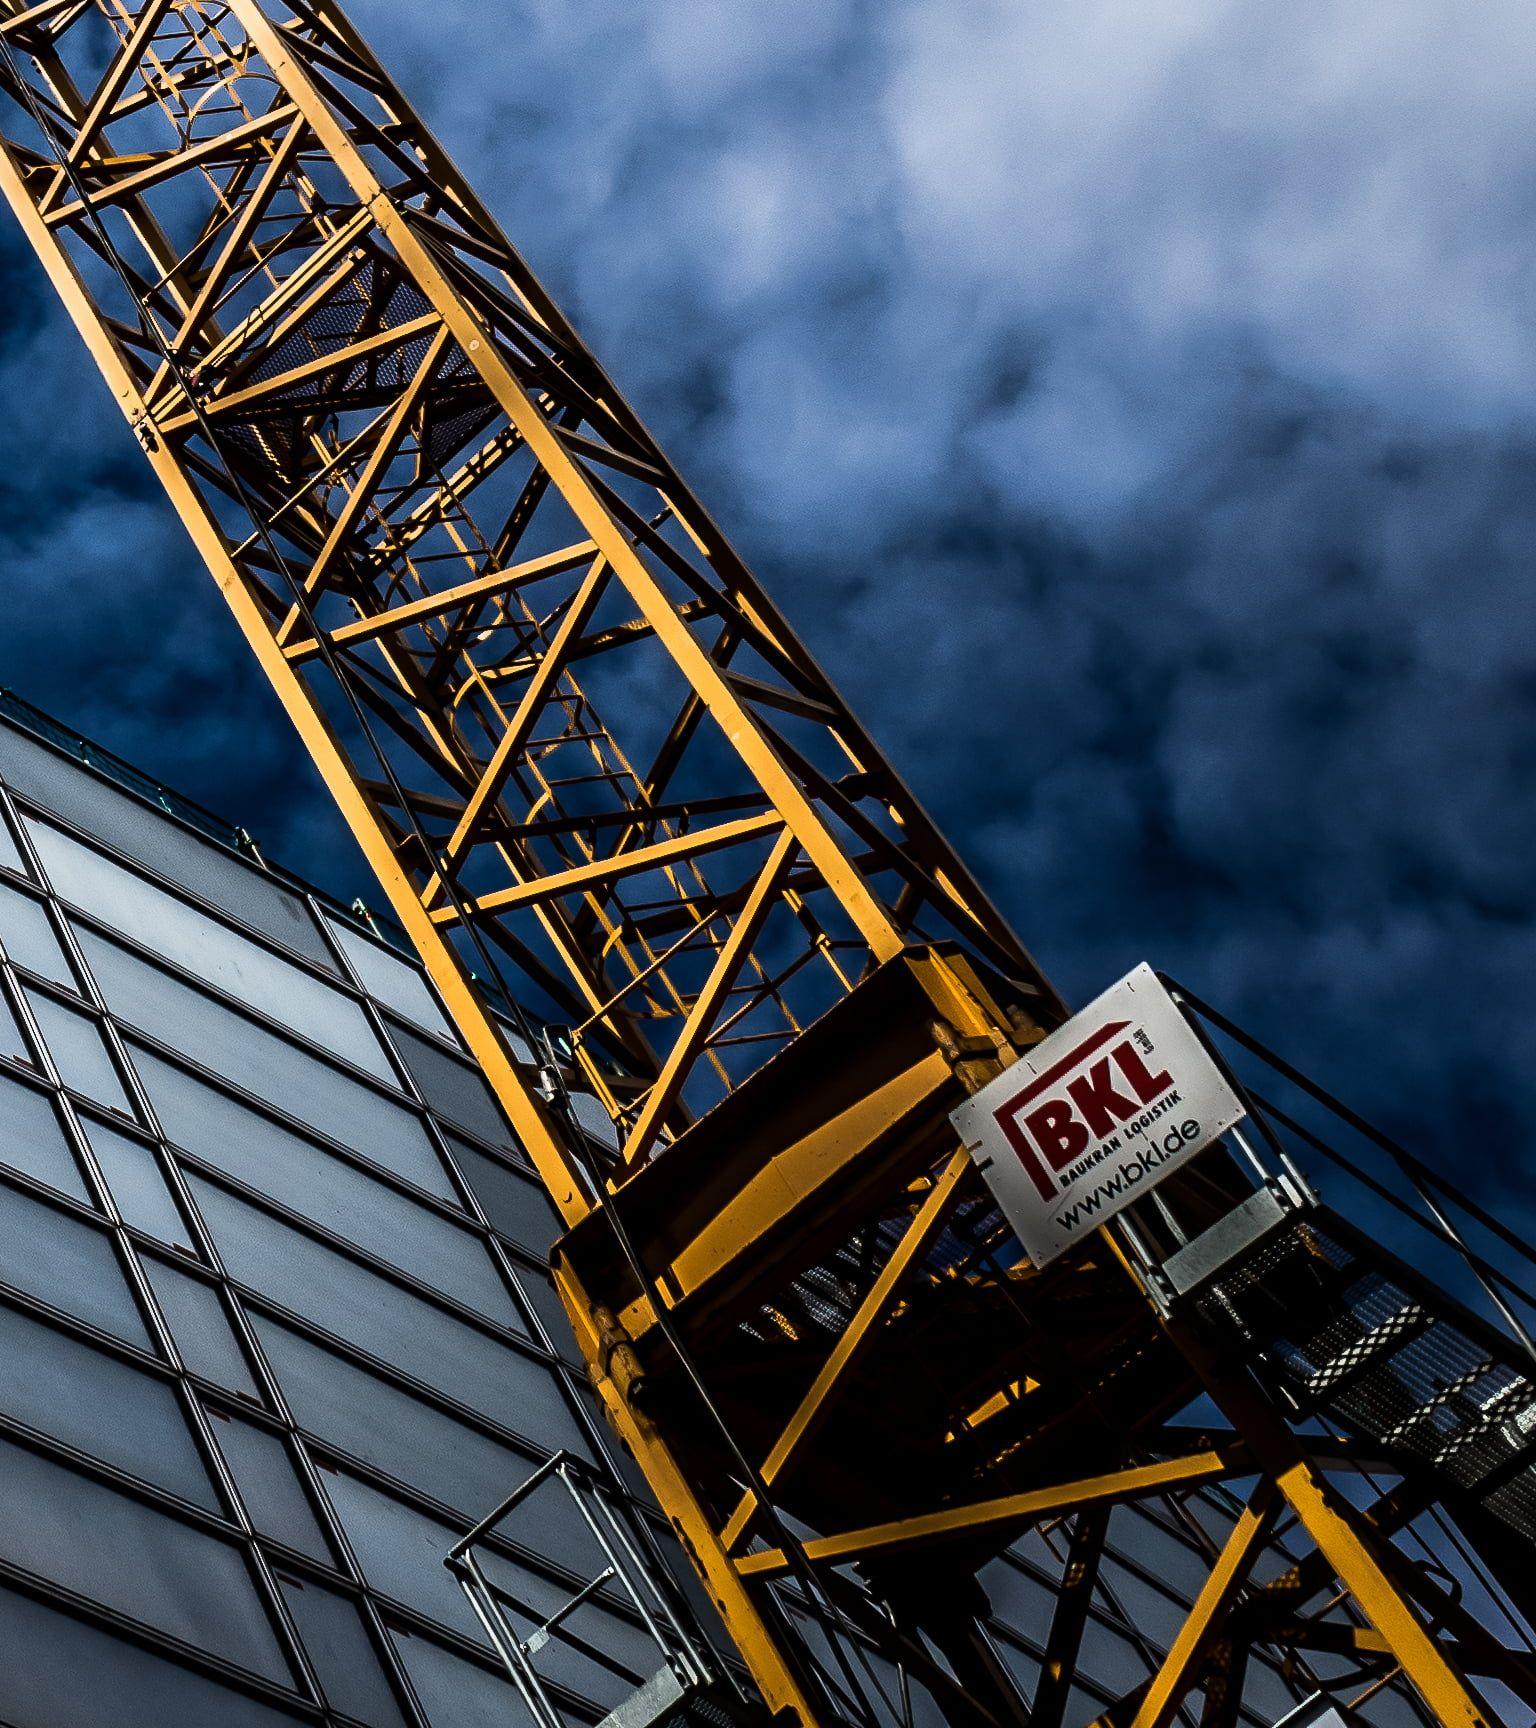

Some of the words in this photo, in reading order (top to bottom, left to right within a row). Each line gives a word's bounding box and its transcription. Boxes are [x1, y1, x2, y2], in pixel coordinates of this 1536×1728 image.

[1024, 1040, 1174, 1173] BKL
[1059, 1137, 1122, 1188] BAUKRAN
[1124, 1089, 1181, 1140] LOGISTIK
[1056, 1118, 1201, 1231] www.bkl.de
